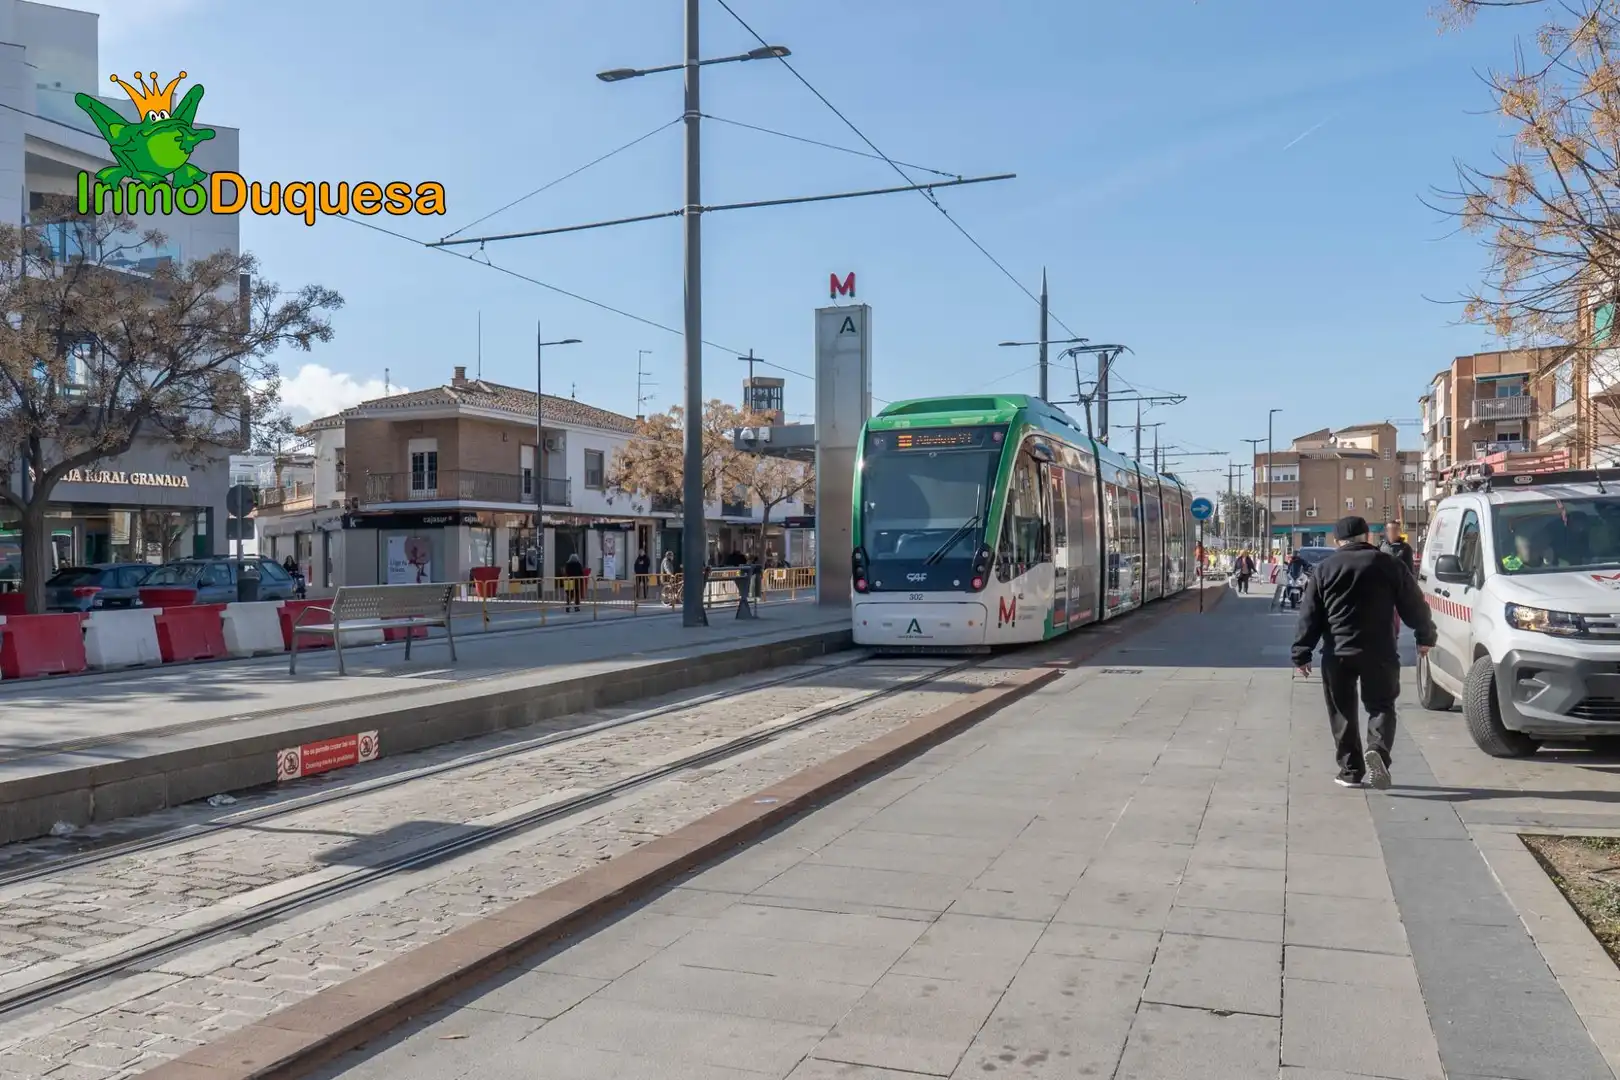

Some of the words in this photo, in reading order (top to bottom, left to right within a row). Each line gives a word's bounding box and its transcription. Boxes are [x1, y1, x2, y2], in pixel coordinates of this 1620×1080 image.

[830, 271, 855, 299] M
[85, 469, 129, 484] RURAL
[130, 472, 189, 488] GRANADA
[423, 515, 447, 525] cajasur
[906, 573, 927, 582] CAF
[909, 593, 924, 601] 302
[998, 595, 1016, 629] M
